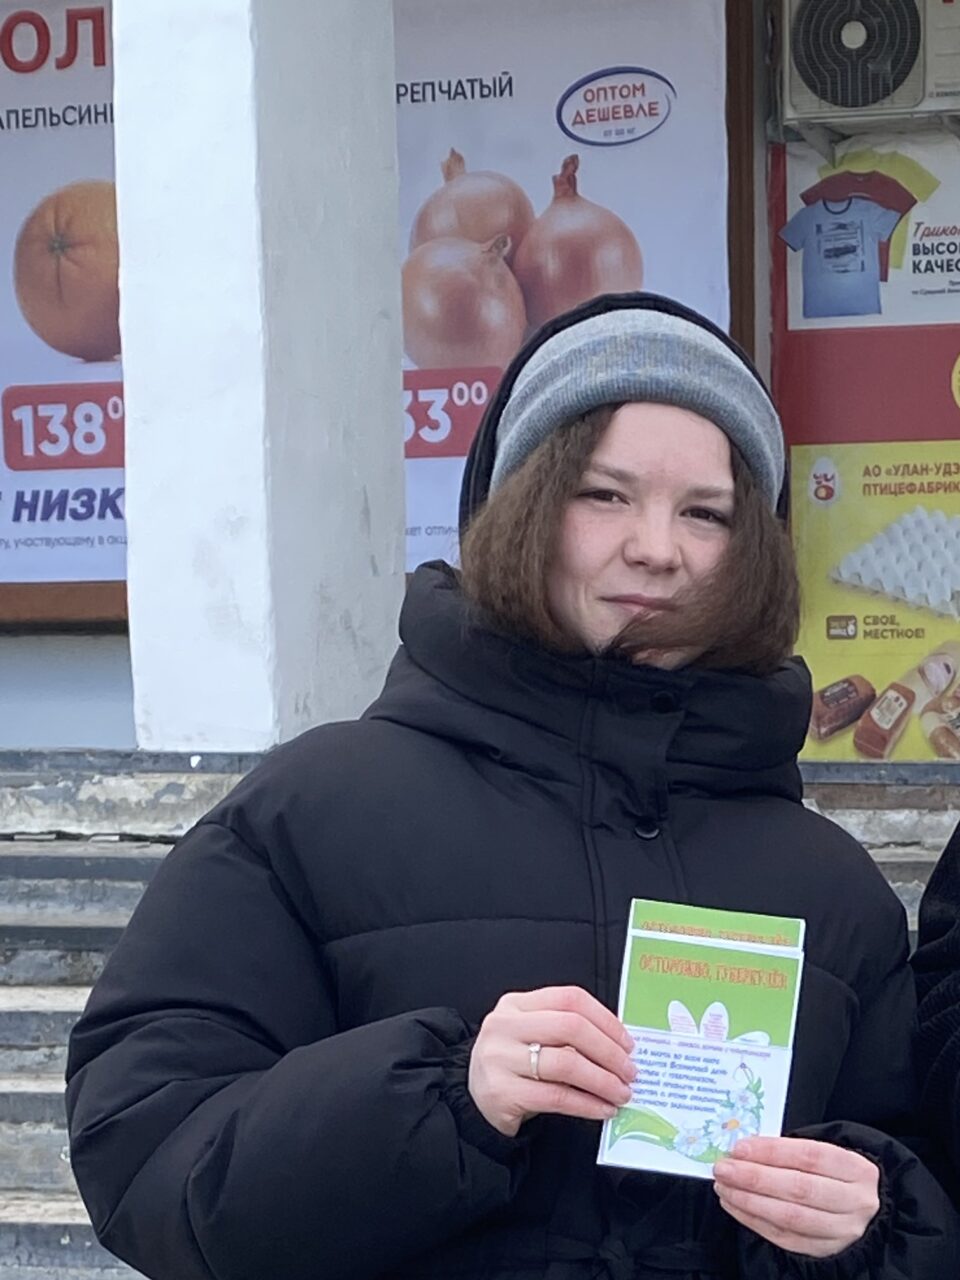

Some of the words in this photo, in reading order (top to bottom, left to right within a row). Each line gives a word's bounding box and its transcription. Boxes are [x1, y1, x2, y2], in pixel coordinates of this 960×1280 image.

[395, 71, 513, 104] РЕПЧАТЫЙ
[583, 82, 646, 104] ОПТОМ
[571, 101, 660, 127] ДЕШЕВЛЕ
[862, 464, 882, 478] АО
[862, 627, 926, 640] МЕСТНОЕ!
